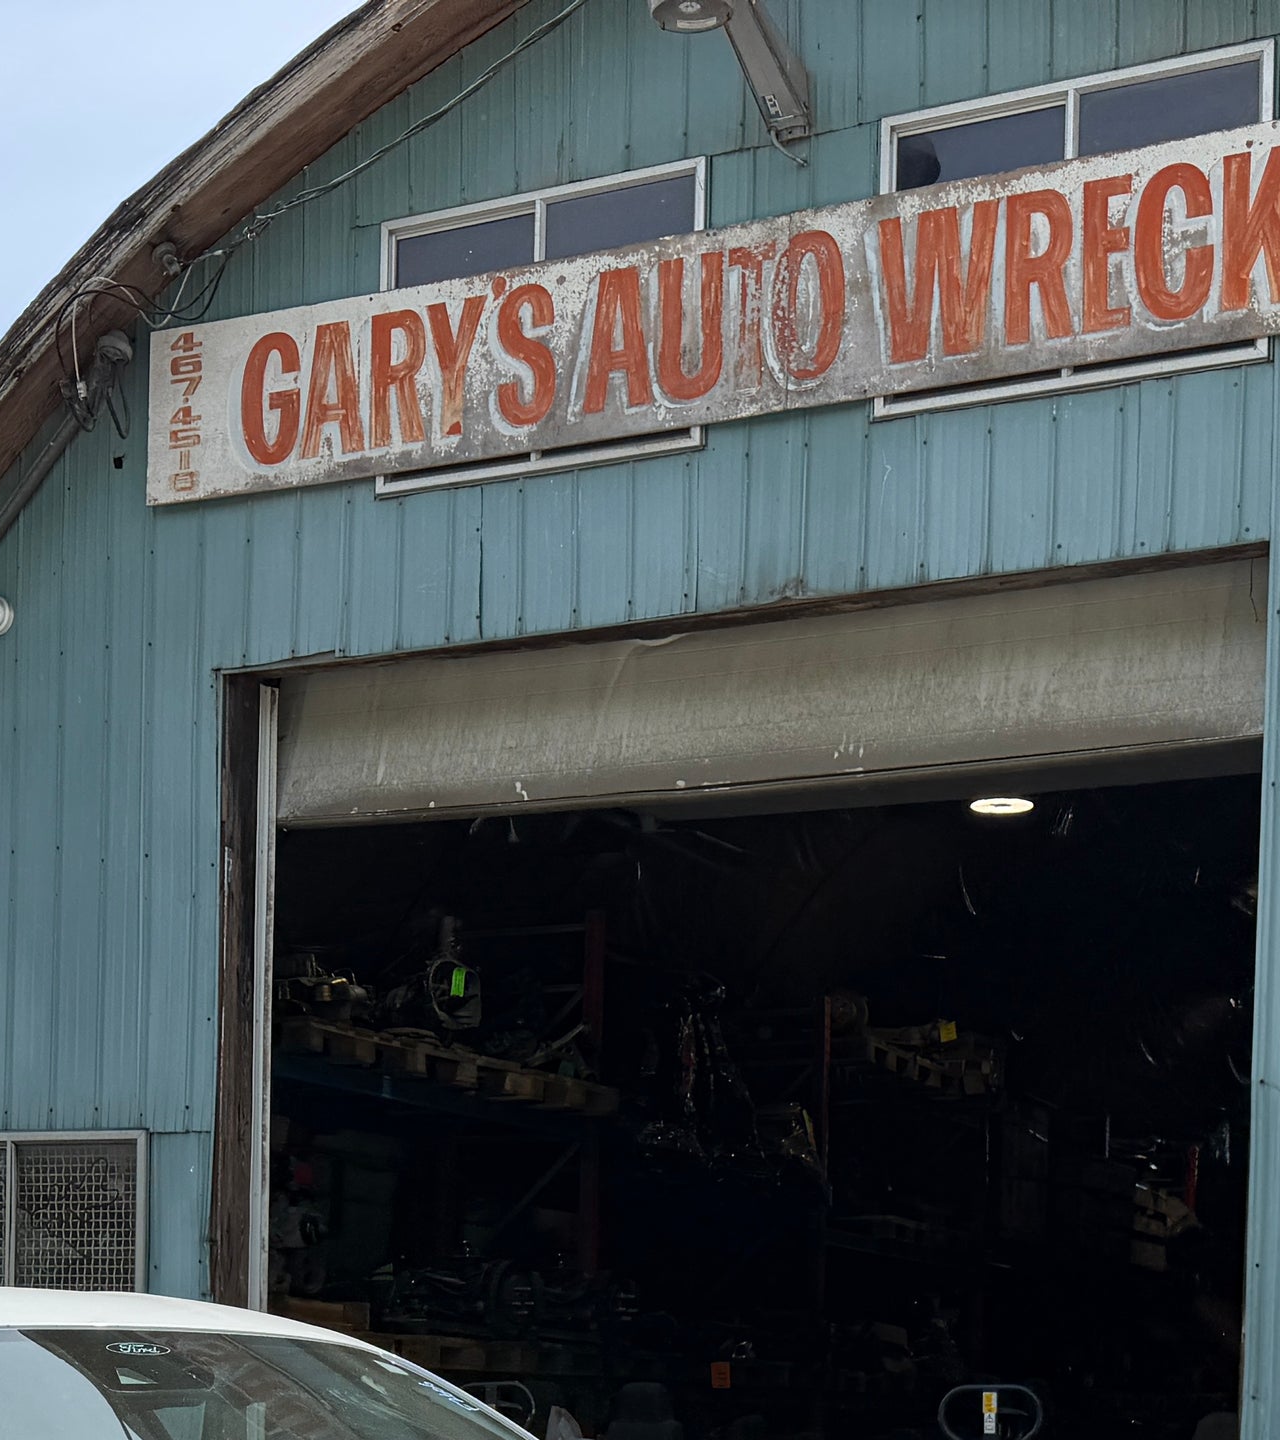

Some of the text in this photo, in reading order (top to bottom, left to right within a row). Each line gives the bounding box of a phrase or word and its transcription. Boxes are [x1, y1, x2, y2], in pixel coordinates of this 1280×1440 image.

[240, 277, 557, 467] GARY'S
[583, 229, 846, 415] AUTO
[118, 1343, 161, 1355] Ford
